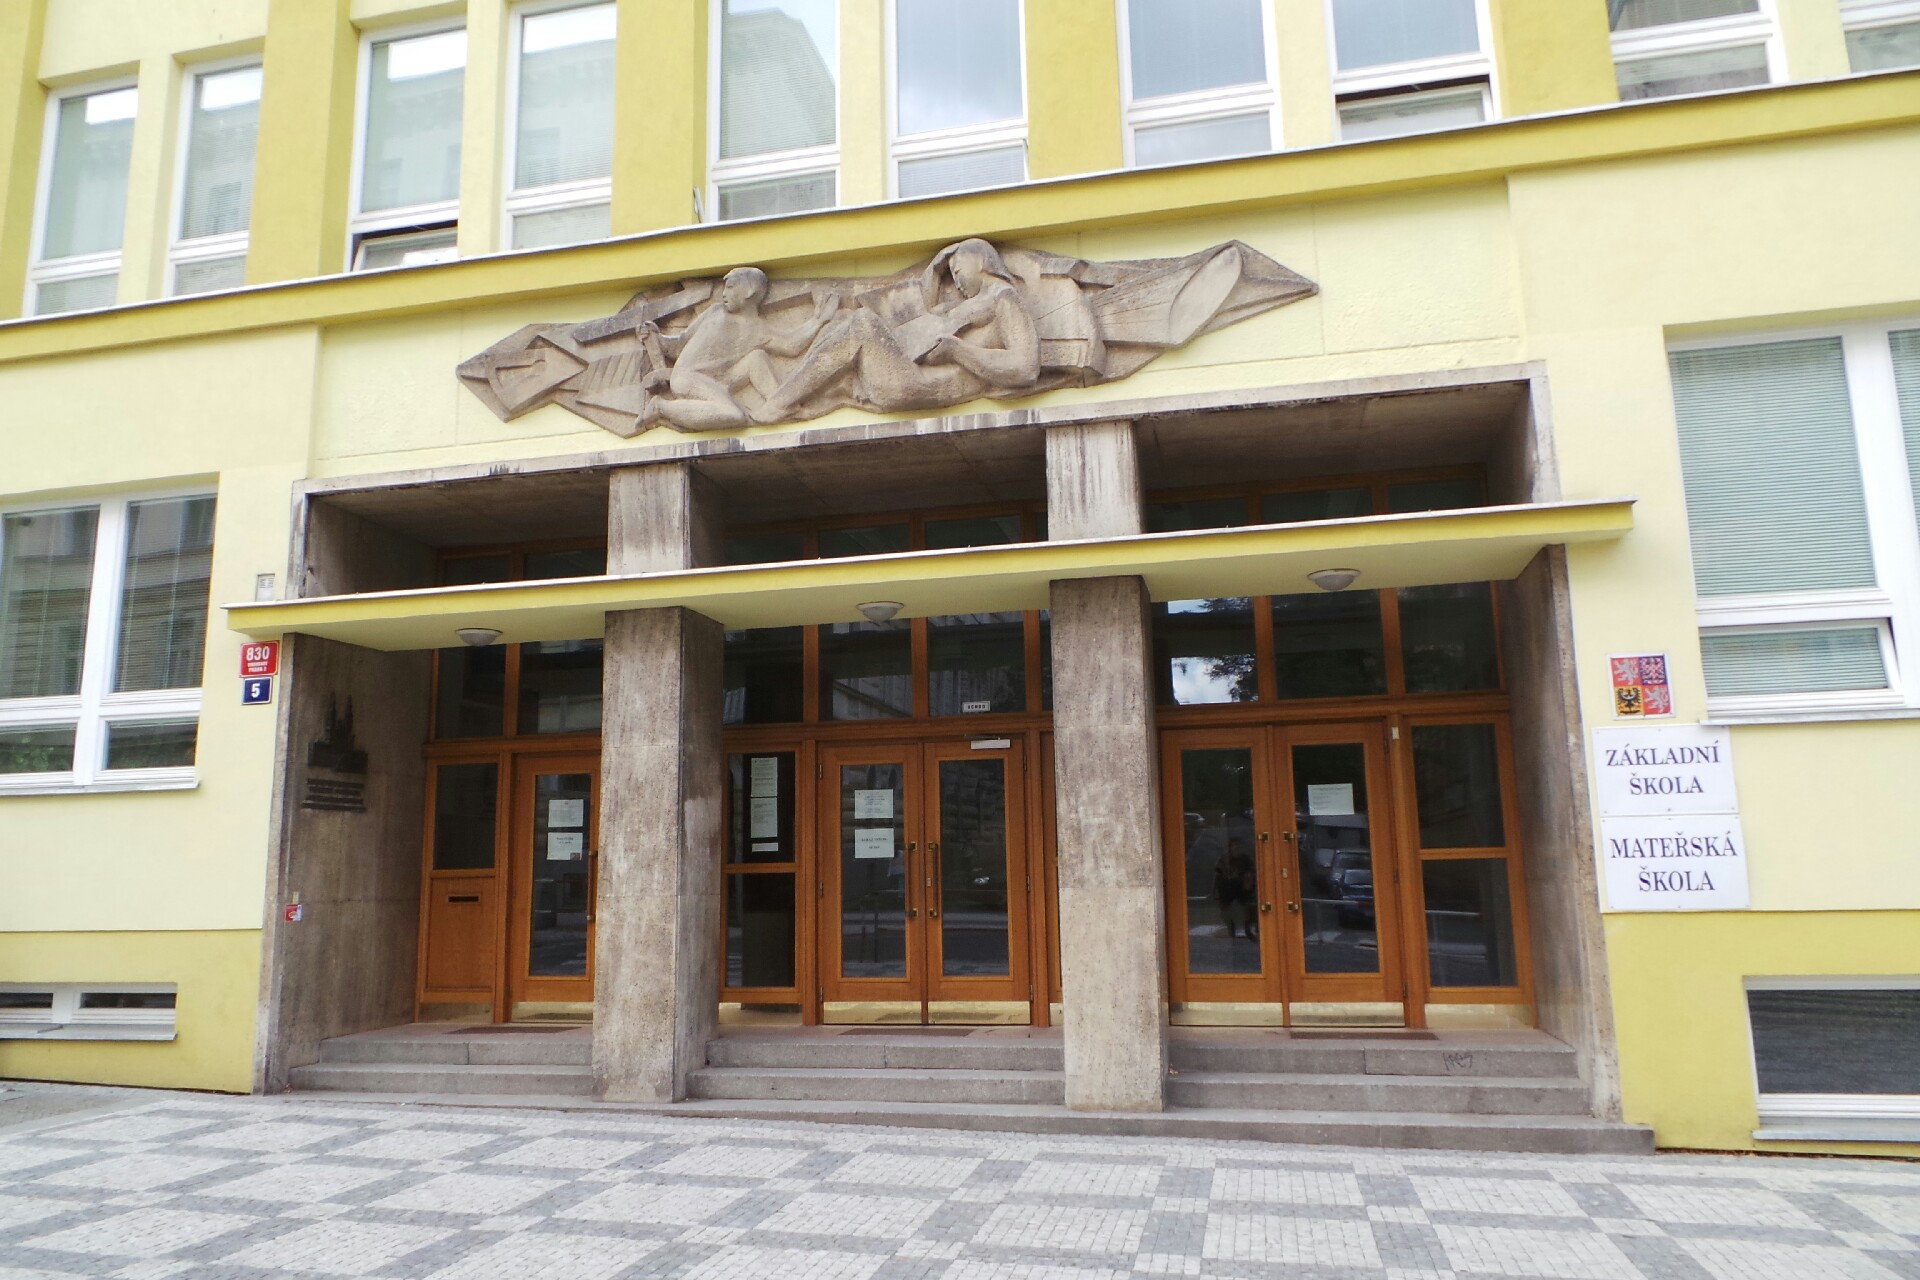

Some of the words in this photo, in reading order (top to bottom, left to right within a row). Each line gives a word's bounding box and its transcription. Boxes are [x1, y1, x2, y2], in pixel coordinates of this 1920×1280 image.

[246, 646, 270, 660] 830
[251, 683, 260, 698] 5
[1605, 740, 1720, 767] ZÁKLADNÍ
[1629, 772, 1704, 795] ŠKOLA
[1610, 831, 1738, 858] MATEŘSKÁ
[1638, 866, 1715, 892] ŠKOLA
